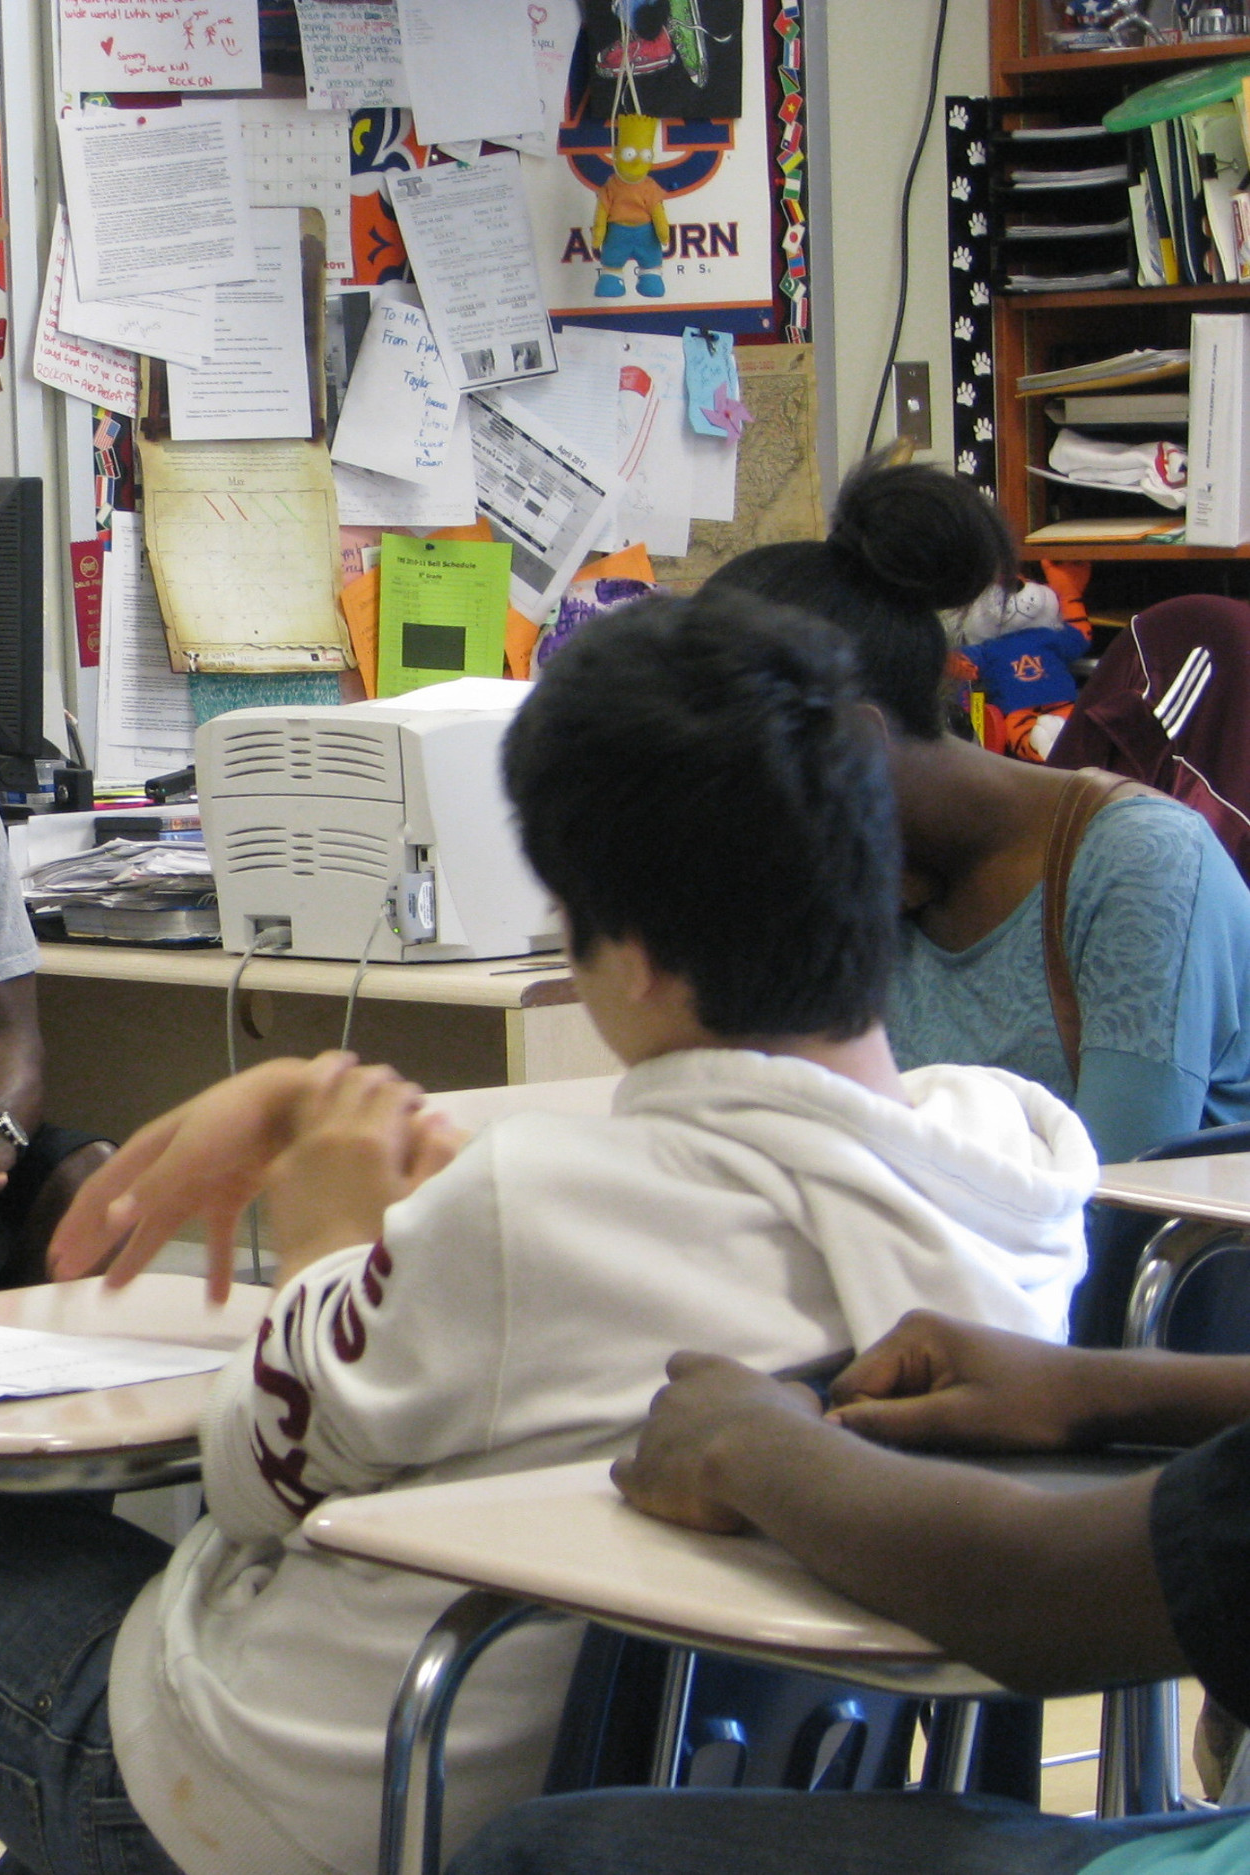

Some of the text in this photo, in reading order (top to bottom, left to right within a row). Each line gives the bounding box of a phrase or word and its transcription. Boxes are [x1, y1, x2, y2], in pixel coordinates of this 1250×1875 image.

[561, 221, 739, 264] AURN
[380, 306, 397, 321] To
[381, 329, 409, 346] From
[403, 369, 434, 392] Taylor
[556, 444, 588, 470] April 2012
